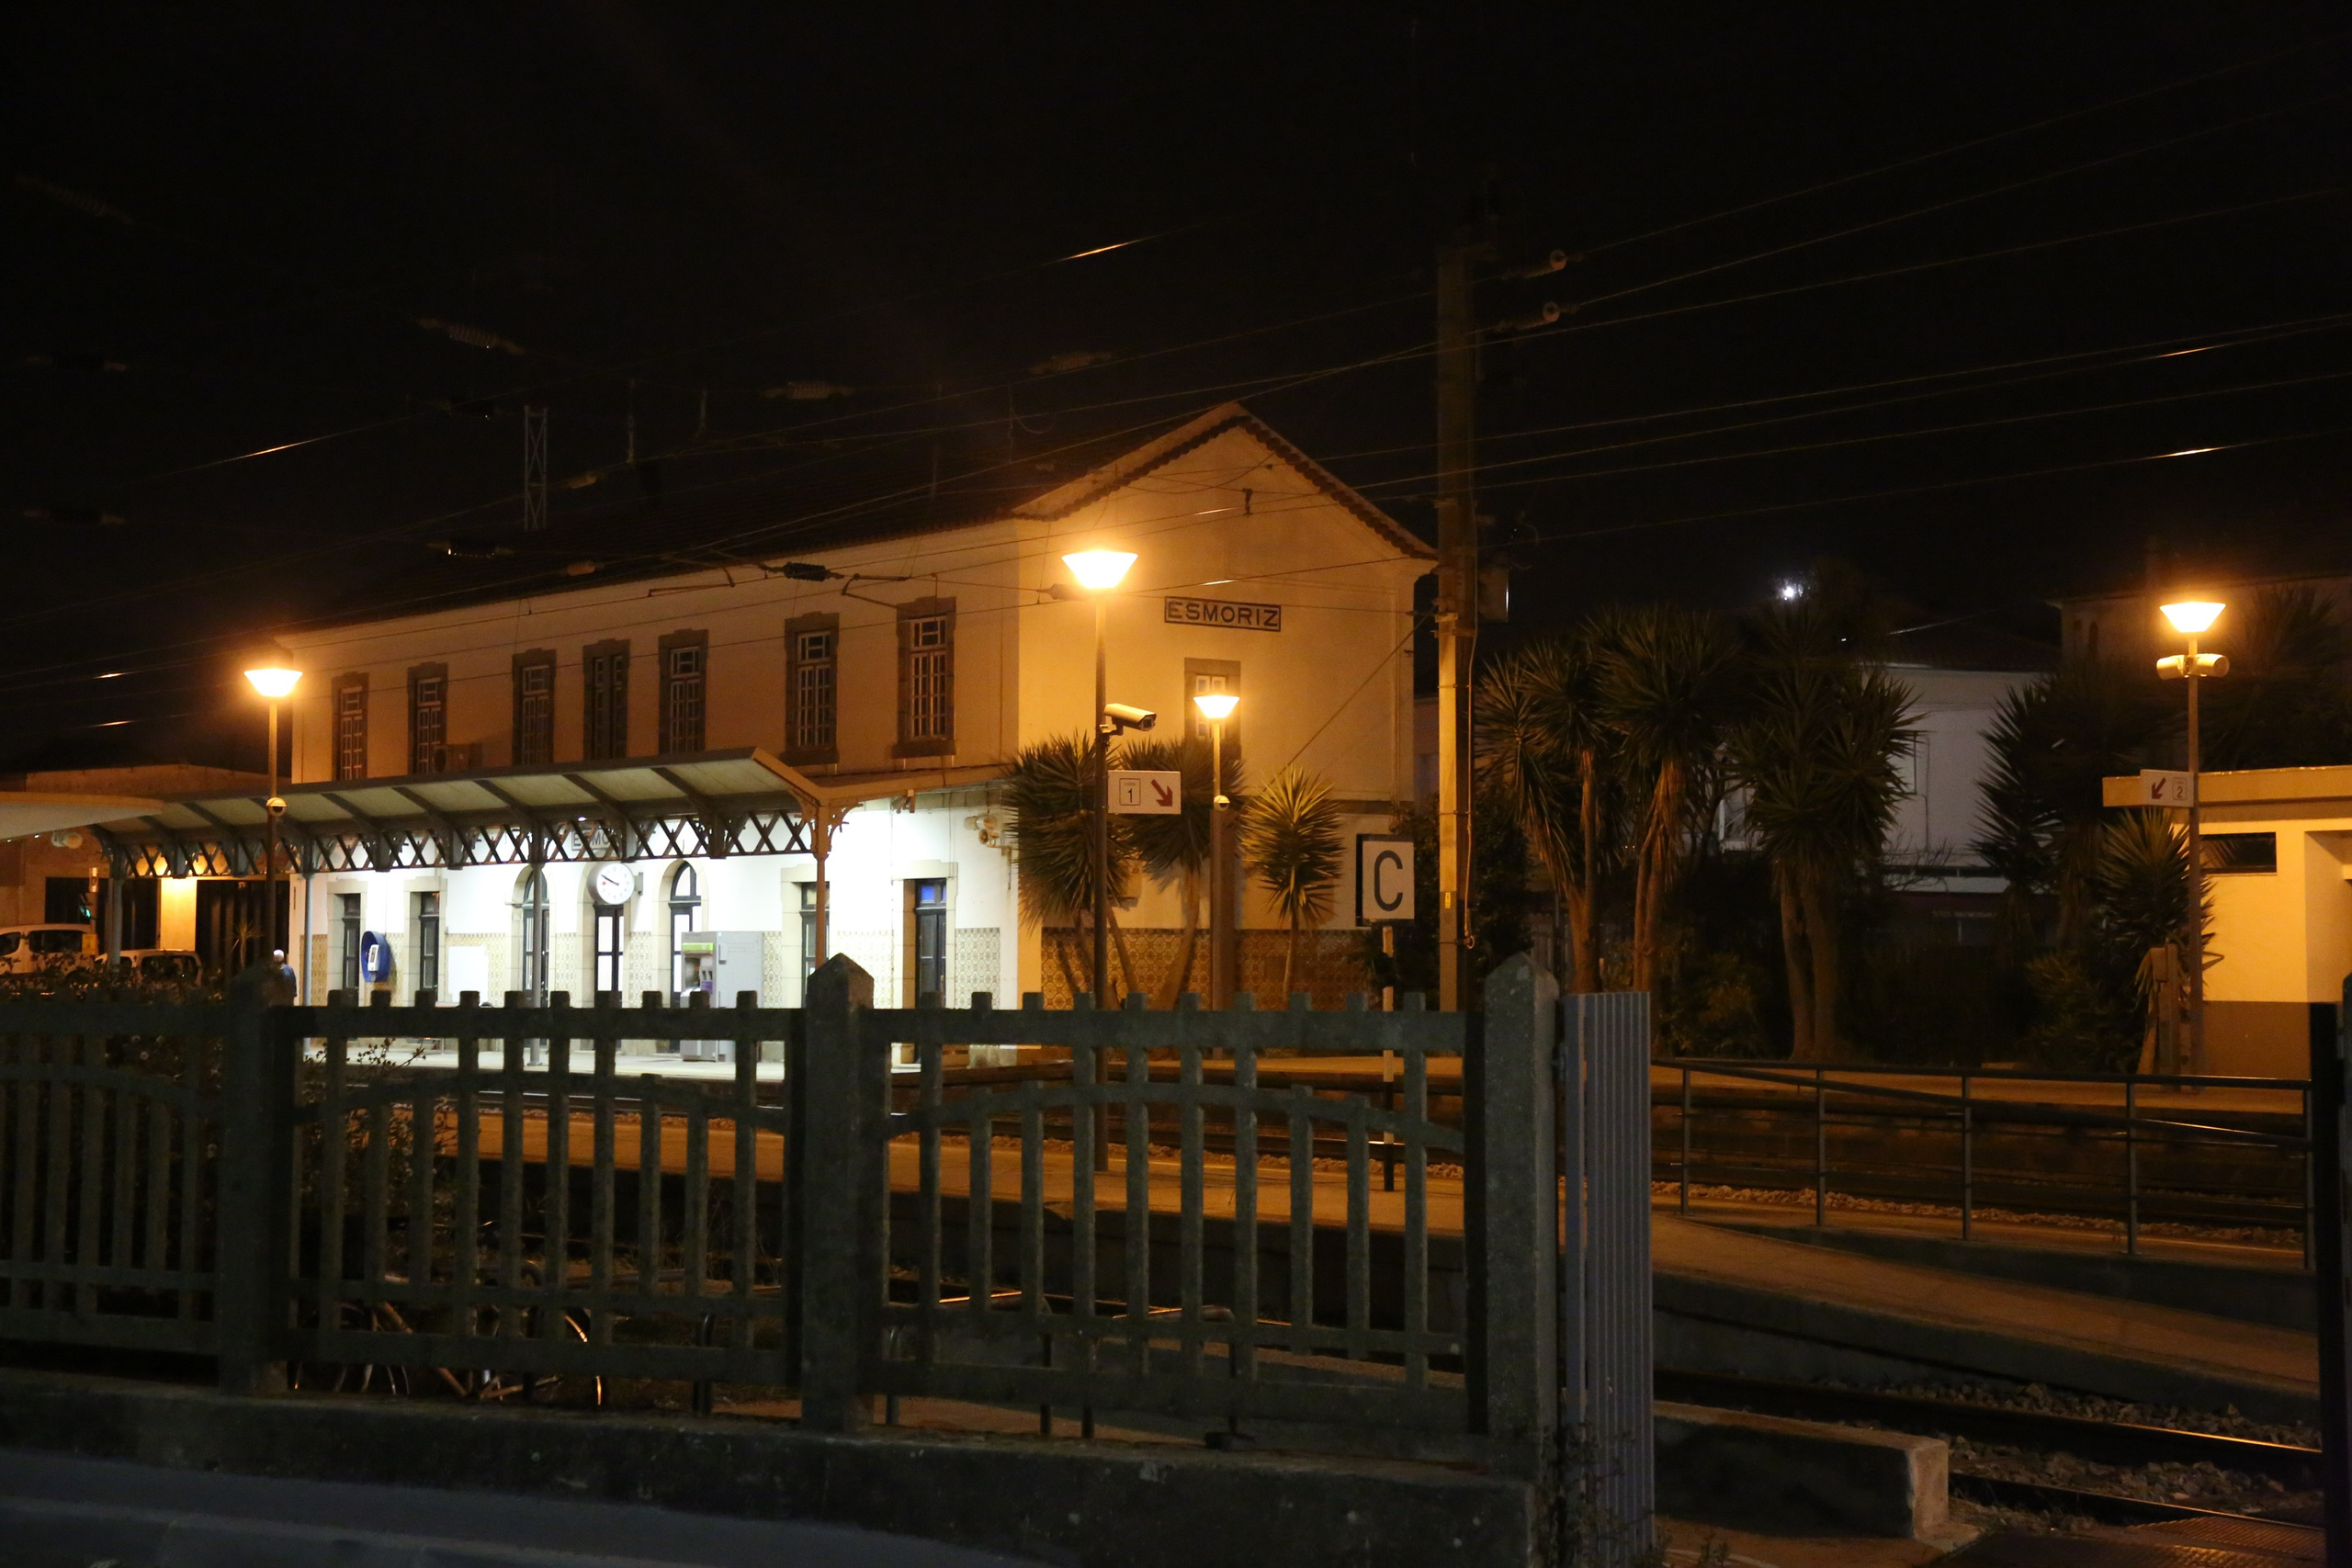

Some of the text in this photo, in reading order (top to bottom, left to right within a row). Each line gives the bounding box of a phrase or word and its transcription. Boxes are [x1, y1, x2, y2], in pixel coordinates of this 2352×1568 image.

[1168, 600, 1279, 627] ESMORIZ
[1127, 788, 1133, 804] 1
[2177, 785, 2184, 798] 2
[1374, 850, 1404, 912] C
